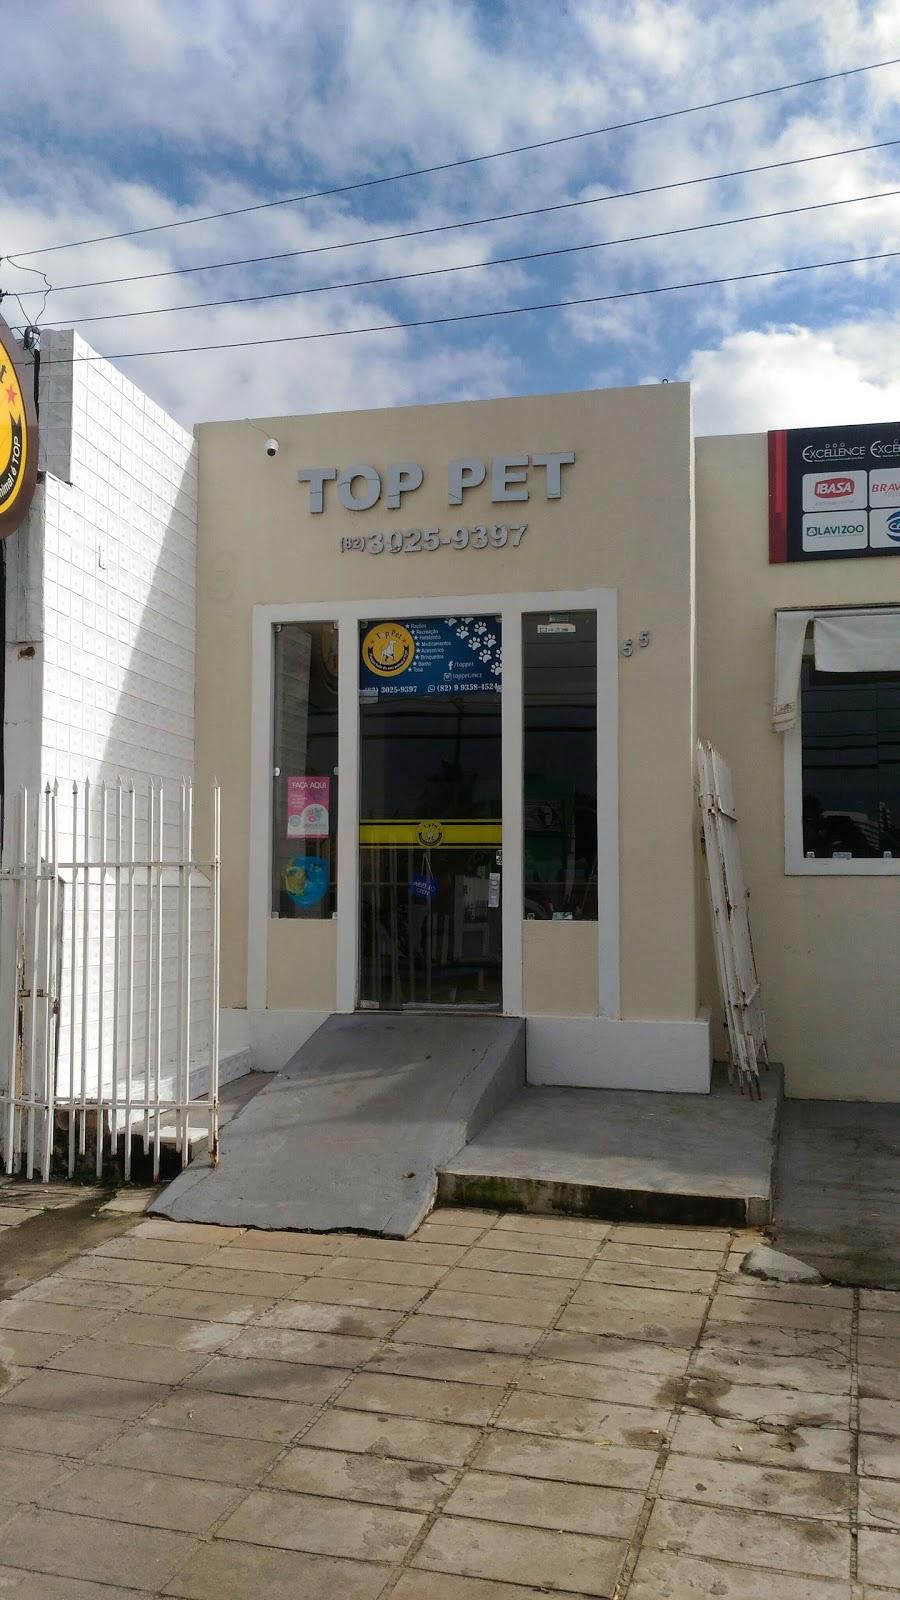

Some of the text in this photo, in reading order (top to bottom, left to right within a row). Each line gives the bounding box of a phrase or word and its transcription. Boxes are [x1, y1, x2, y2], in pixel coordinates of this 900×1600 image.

[11, 435, 21, 466] TOP
[298, 451, 576, 514] TOP PET
[816, 482, 852, 494] IBASA
[818, 524, 865, 536] LAVIZOO
[380, 685, 418, 694] 3025-9397
[436, 684, 452, 692] (82)
[310, 781, 326, 789] AQUI
